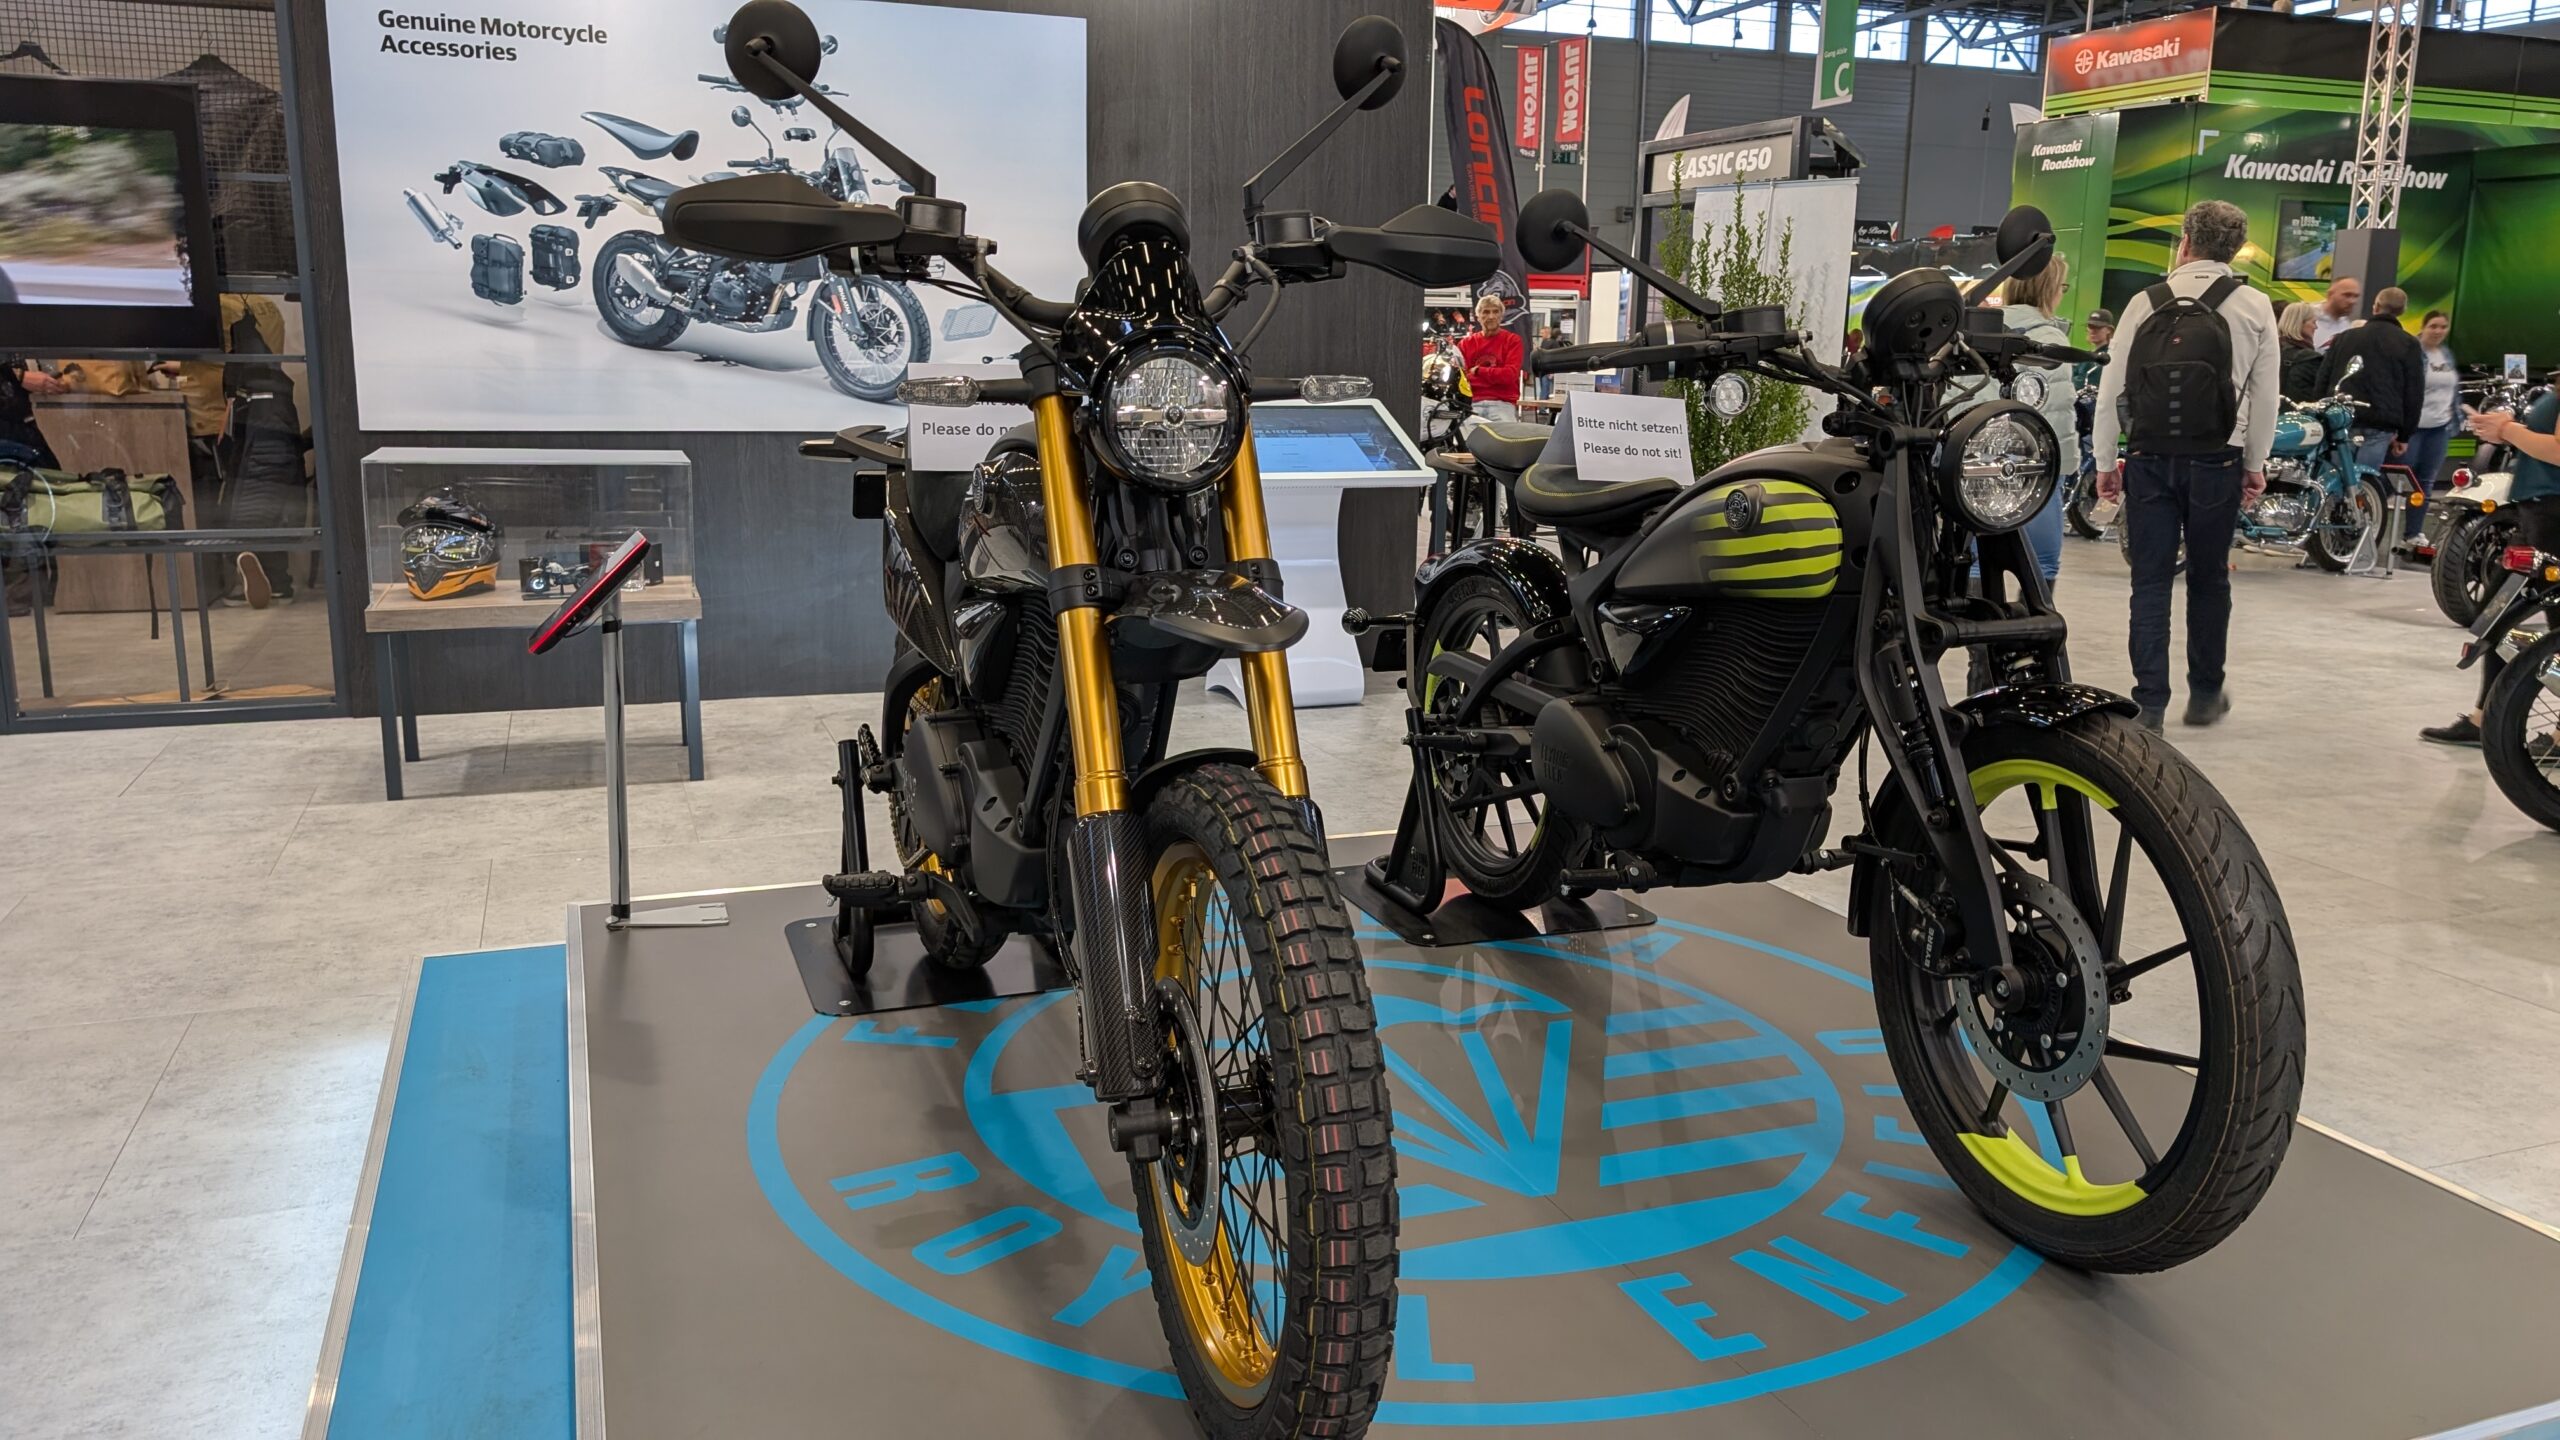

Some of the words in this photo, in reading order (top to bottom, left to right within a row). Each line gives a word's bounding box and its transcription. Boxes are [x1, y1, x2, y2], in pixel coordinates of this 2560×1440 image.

[378, 9, 476, 34] Genuine
[480, 17, 608, 46] Motorcycle
[380, 34, 517, 61] Accessories
[2095, 37, 2180, 69] Kawasaki
[1834, 62, 1850, 97] C
[2031, 139, 2084, 157] Kawasaki
[1667, 150, 1734, 181] CLASSIC
[1735, 147, 1772, 172] 650
[2041, 155, 2096, 171] Roadshow
[2224, 153, 2336, 184] Kawasaki
[2337, 160, 2448, 190] Roadhow
[922, 422, 971, 436] Please
[976, 423, 994, 436] do
[1577, 416, 1605, 429] Bitte
[1609, 419, 1639, 432] nicht
[1641, 423, 1683, 435] setzen!
[1583, 442, 1621, 455] Please
[1624, 445, 1639, 456] do
[1642, 448, 1661, 458] not
[1664, 448, 1682, 459] sit!
[1924, 927, 1935, 968] BYBRE
